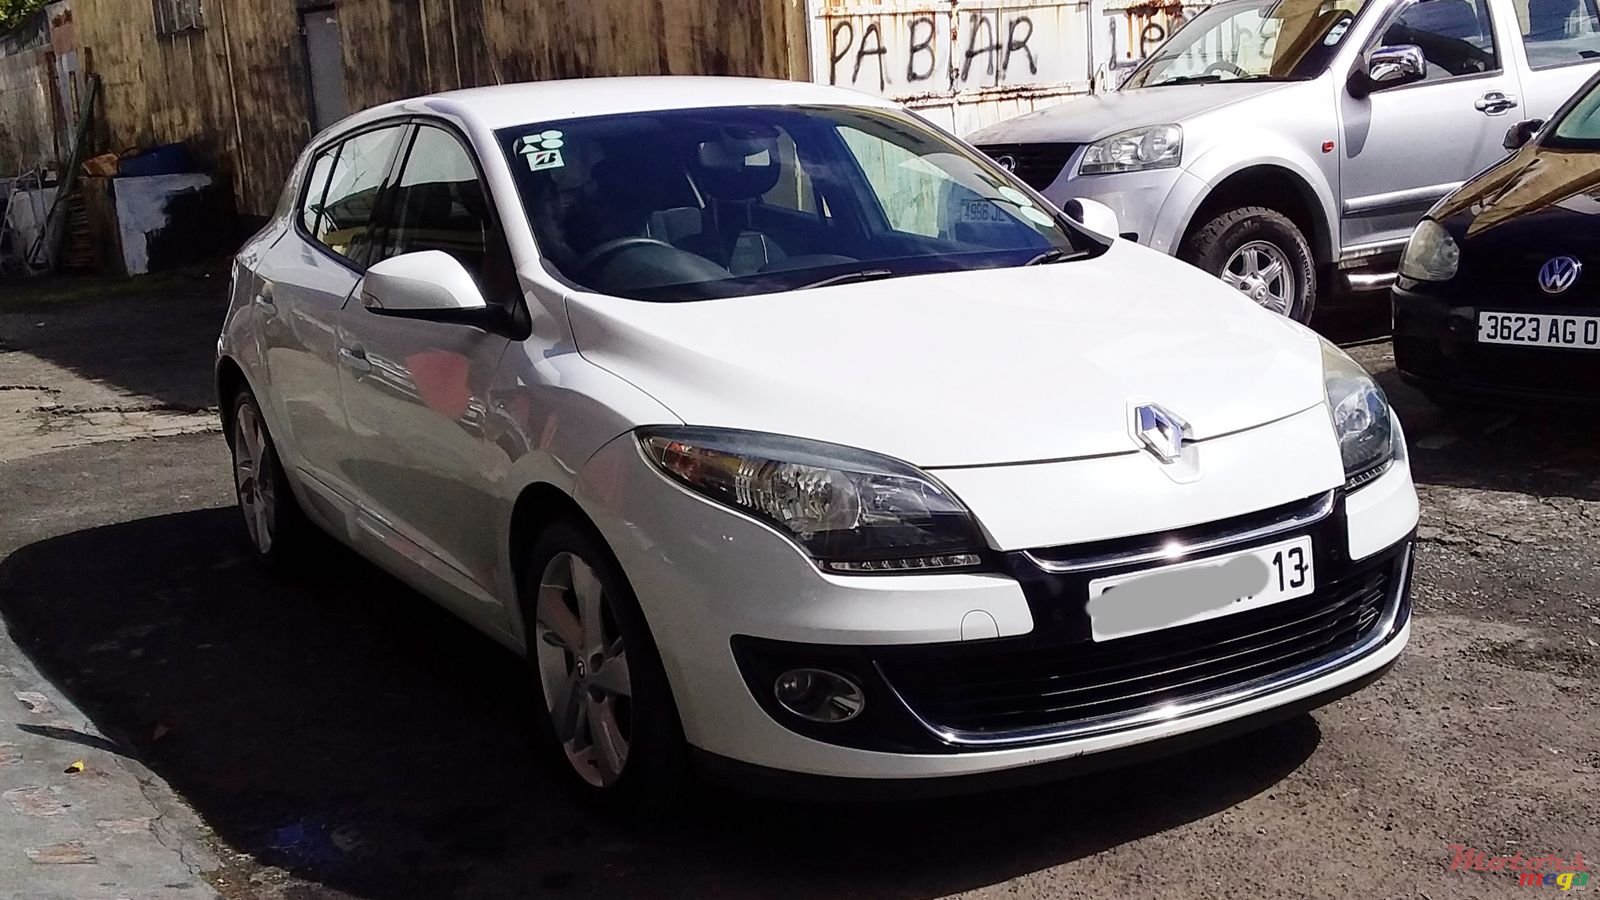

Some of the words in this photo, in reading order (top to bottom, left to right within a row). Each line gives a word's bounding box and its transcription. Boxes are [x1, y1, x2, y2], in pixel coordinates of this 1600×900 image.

[1486, 315, 1541, 342] 3623
[1547, 318, 1577, 344] AG
[1272, 546, 1306, 592] 13
